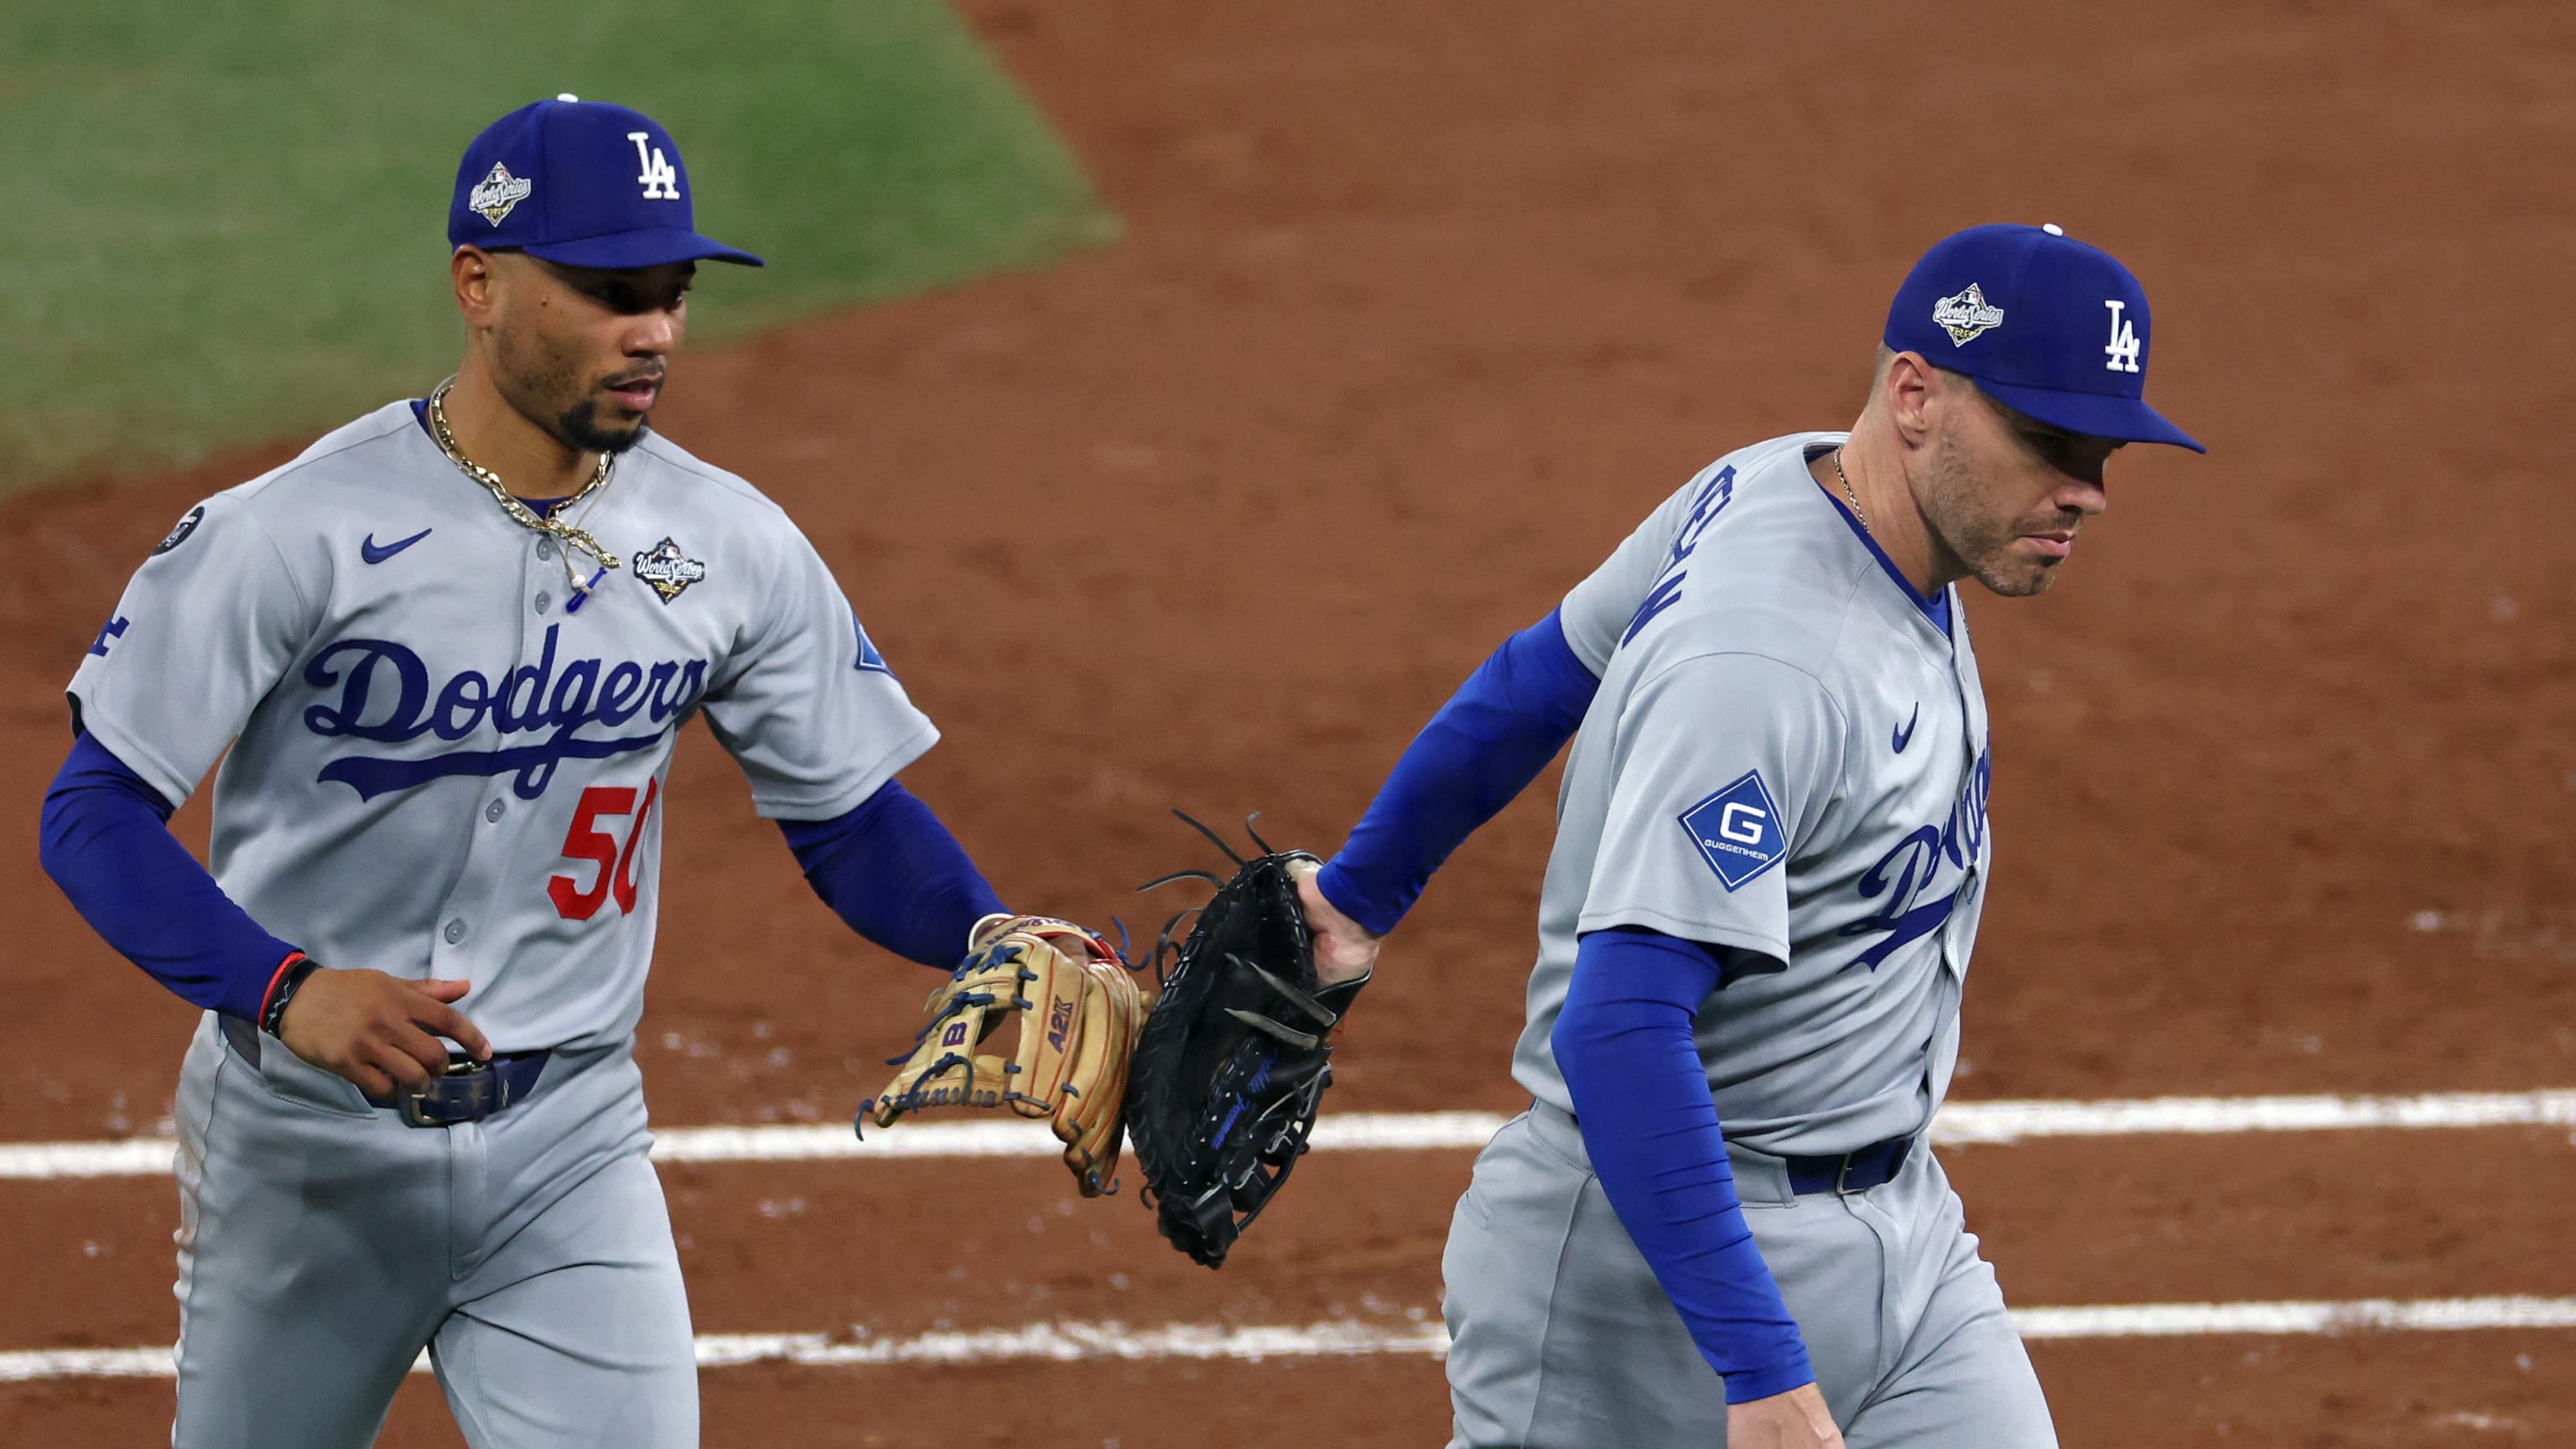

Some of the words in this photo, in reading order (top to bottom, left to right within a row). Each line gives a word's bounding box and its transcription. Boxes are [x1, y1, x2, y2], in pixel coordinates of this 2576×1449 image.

[627, 132, 680, 200] LA
[470, 184, 501, 208] World
[495, 179, 529, 206] Series
[1935, 299, 1971, 319] World
[1963, 304, 2001, 328] Series
[2104, 299, 2140, 373] LA
[636, 553, 672, 574] World
[666, 558, 703, 584] Series
[304, 623, 708, 800] Dodgers
[1720, 802, 1766, 844] G
[1704, 839, 1768, 861] GUGGENHEIM
[1048, 995, 1073, 1055] A2K
